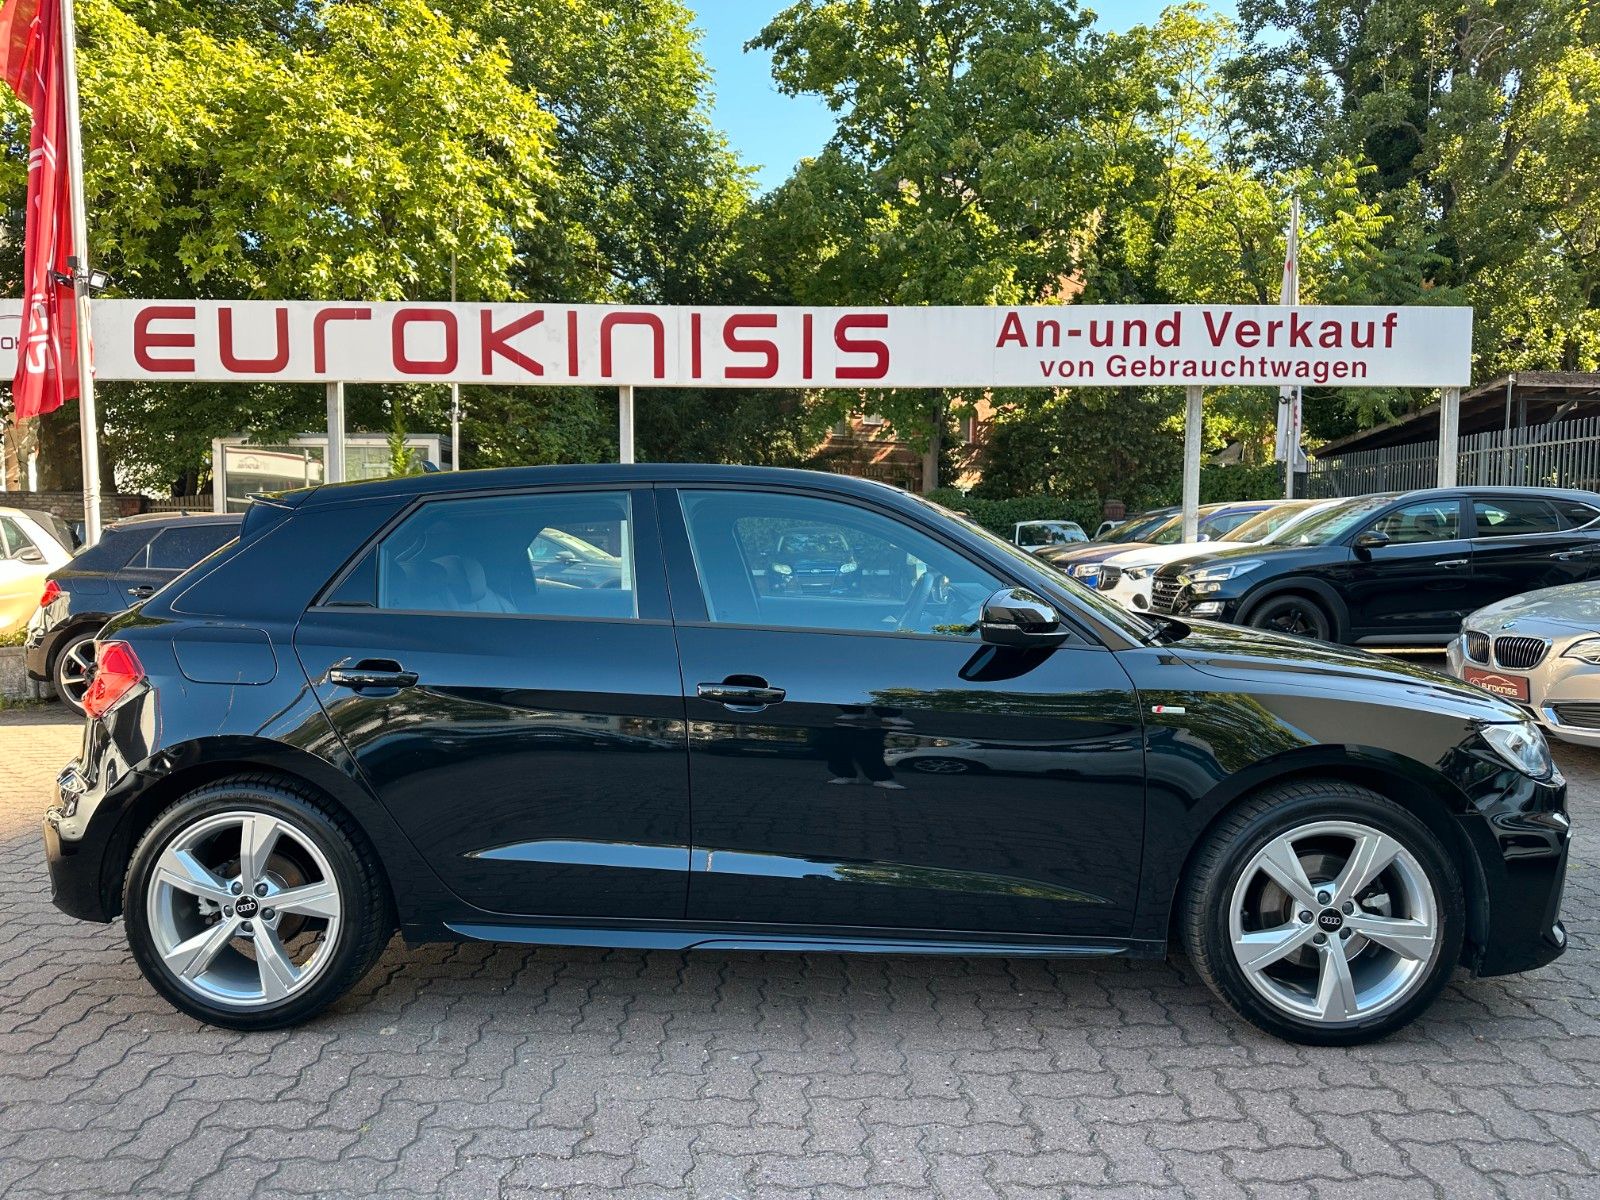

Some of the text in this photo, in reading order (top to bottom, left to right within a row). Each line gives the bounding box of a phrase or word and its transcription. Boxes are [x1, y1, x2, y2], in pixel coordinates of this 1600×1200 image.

[996, 312, 1398, 348] An-und Verkauf
[1040, 355, 1368, 384] von Gebrauchtwagen
